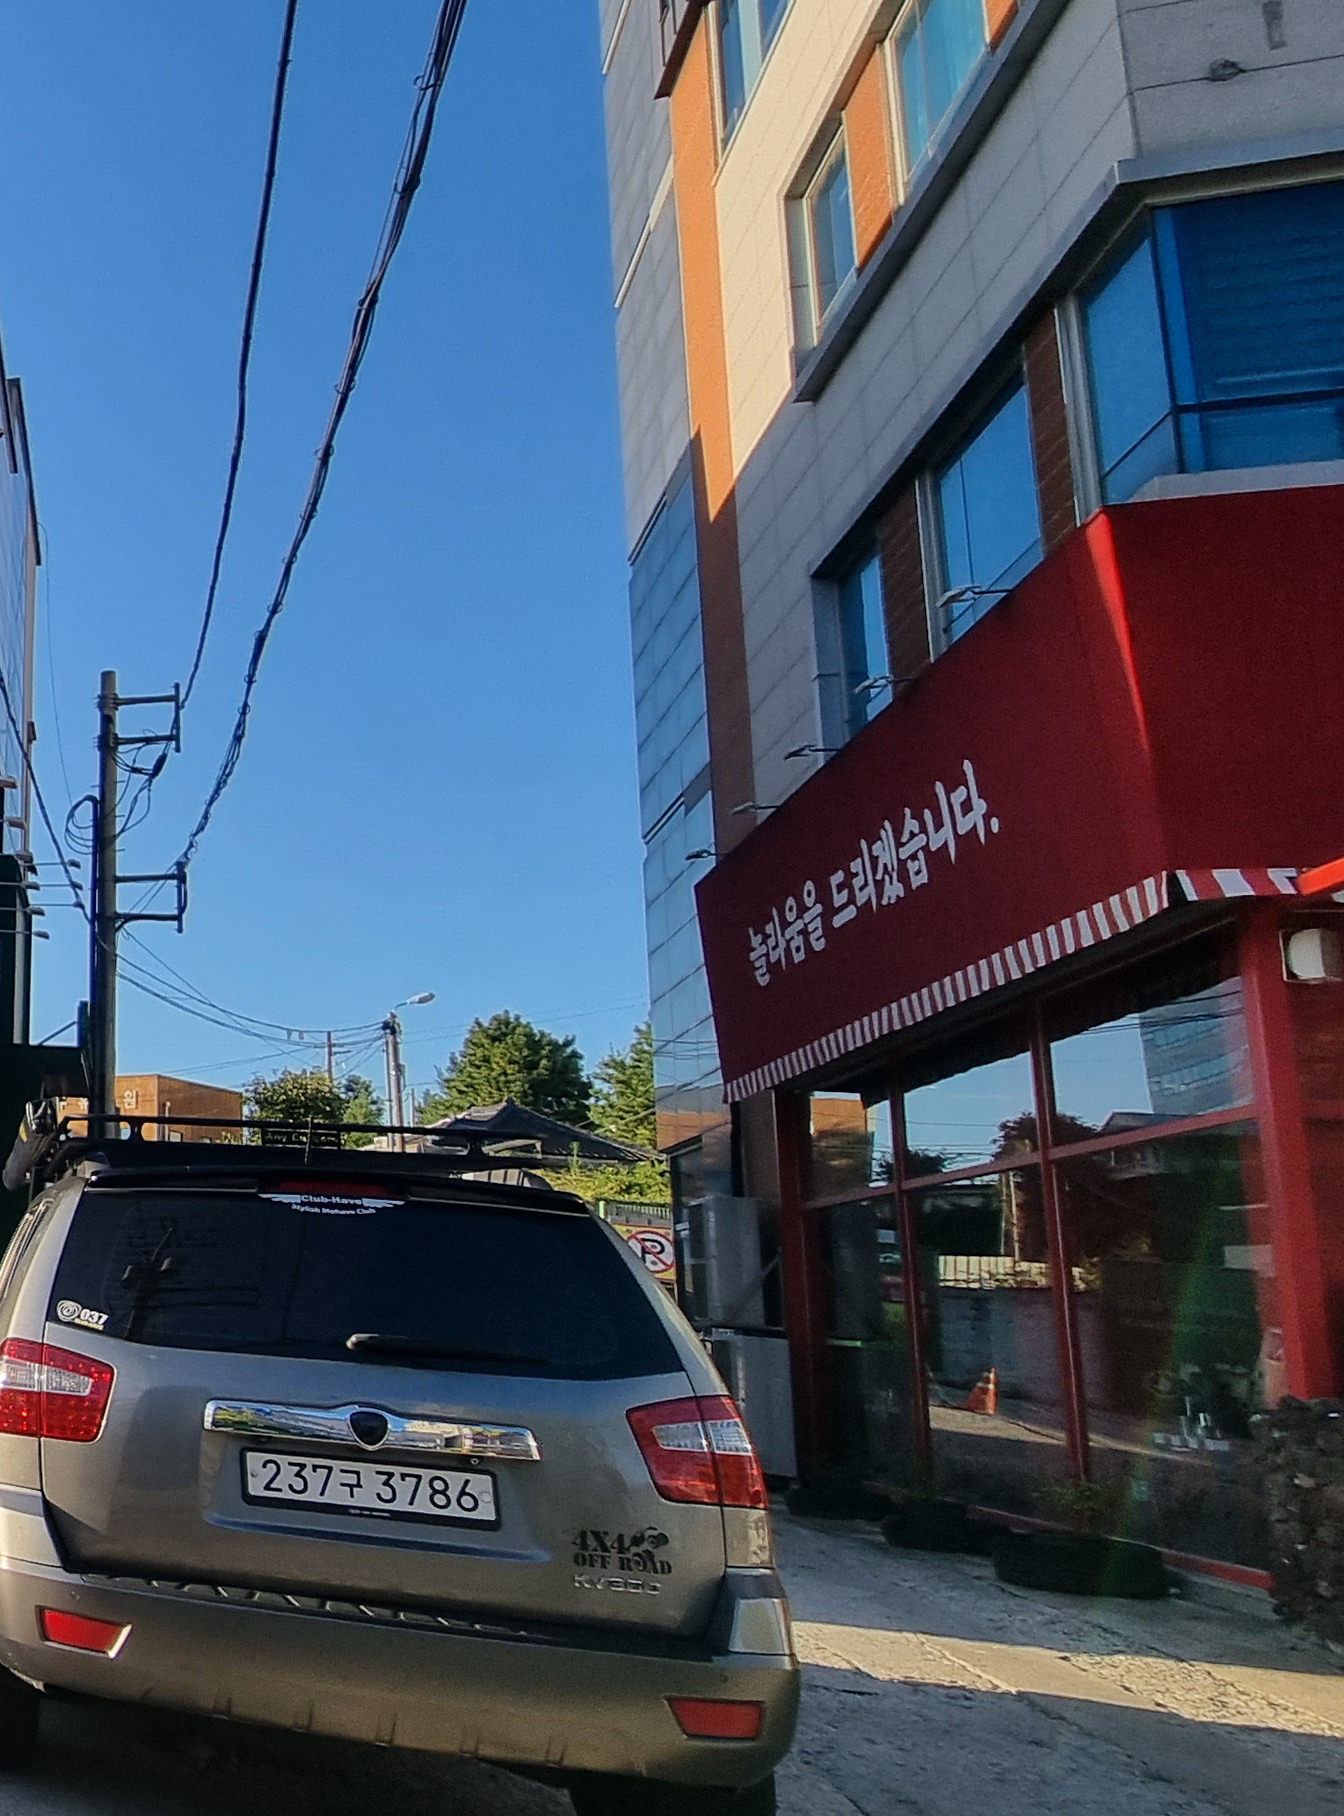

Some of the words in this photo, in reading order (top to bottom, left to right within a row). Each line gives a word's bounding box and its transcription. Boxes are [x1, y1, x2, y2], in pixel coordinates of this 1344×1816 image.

[749, 880, 826, 986] 놀라움을
[830, 759, 1000, 928] 드리겠습니다.
[80, 1308, 109, 1326] 037
[261, 1458, 364, 1499] 237구
[375, 1470, 480, 1512] 3786
[573, 1552, 611, 1569] OFF
